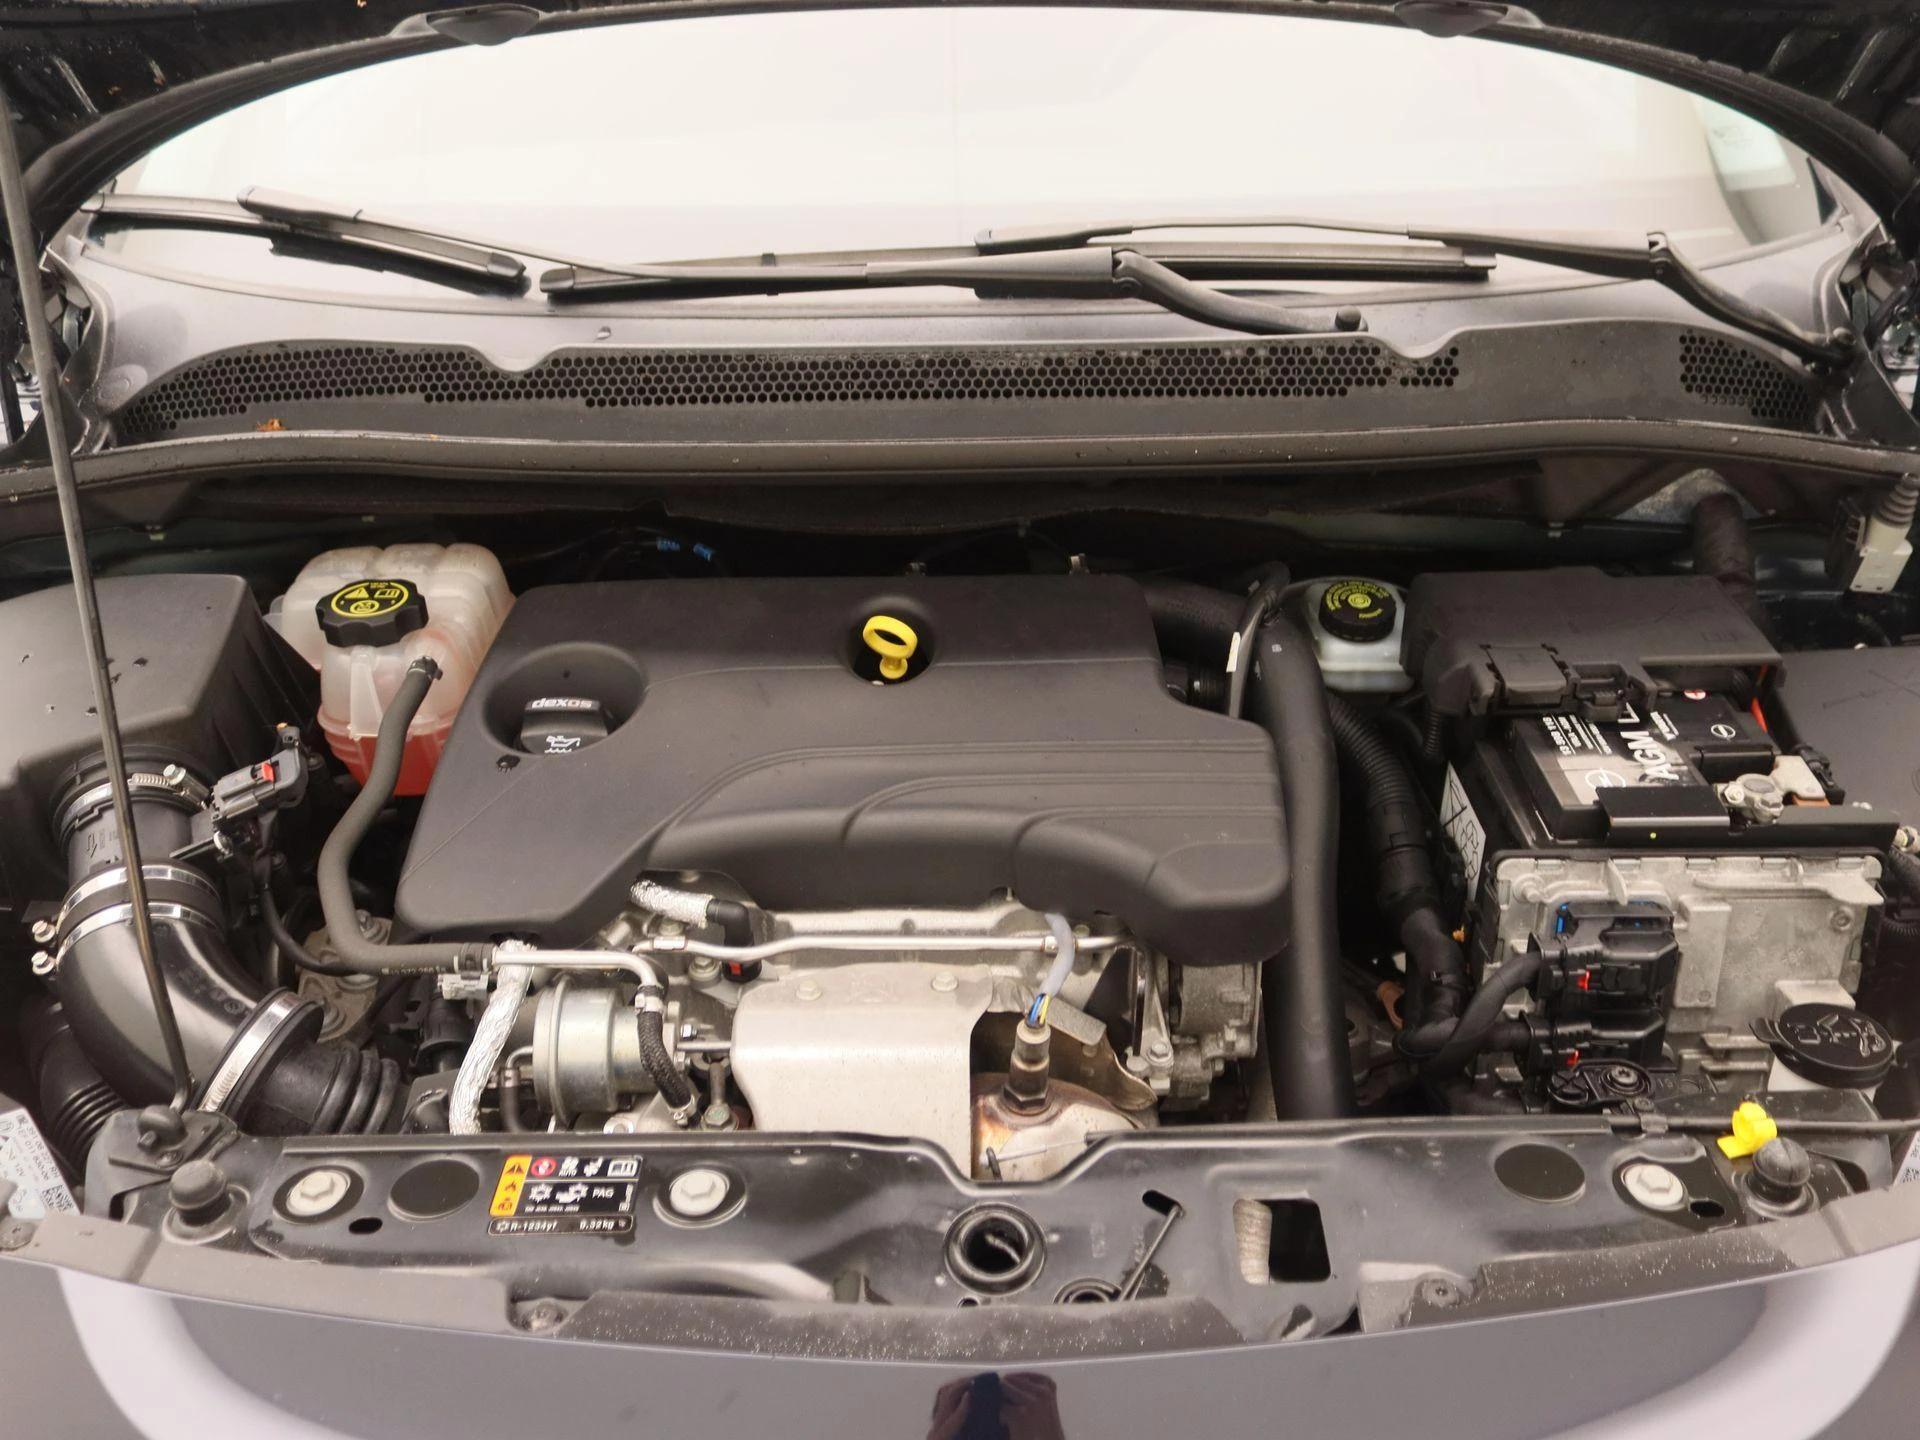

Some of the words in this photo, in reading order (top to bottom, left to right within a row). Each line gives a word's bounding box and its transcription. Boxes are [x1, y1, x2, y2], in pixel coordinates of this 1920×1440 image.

[531, 697, 593, 709] dexos
[1620, 731, 1680, 780] AGM
[558, 1168, 578, 1177] AUTO
[592, 1187, 615, 1199] PAG
